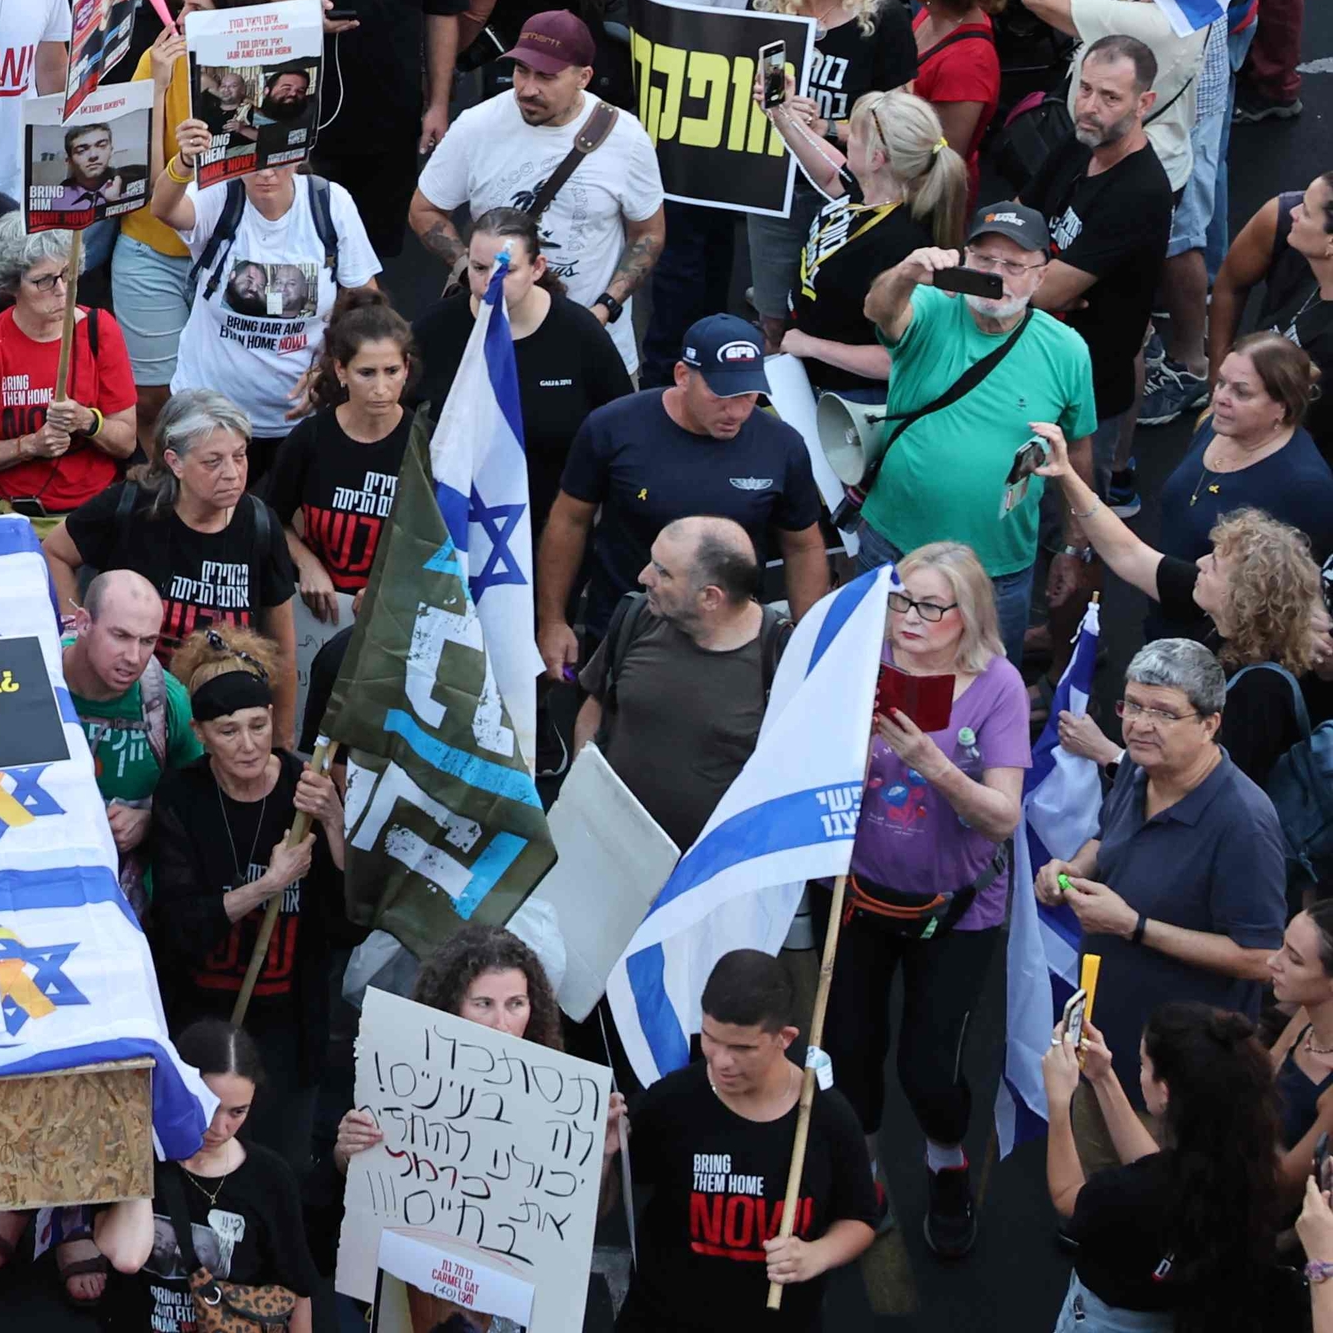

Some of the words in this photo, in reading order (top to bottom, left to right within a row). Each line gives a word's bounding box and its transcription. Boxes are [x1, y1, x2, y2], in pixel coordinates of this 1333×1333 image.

[241, 50, 255, 60] AND
[256, 48, 273, 58] EITAN
[274, 46, 292, 57] HORN
[199, 145, 227, 166] THEM
[28, 184, 64, 204] BRING
[29, 197, 52, 213] HIM
[28, 210, 61, 227] HOME
[63, 208, 95, 224] NOW!
[227, 315, 258, 333] BRING
[259, 320, 281, 336] IAIR
[282, 321, 306, 336] AND
[246, 334, 277, 352] HOME
[276, 333, 308, 351] NOW!
[1, 374, 29, 392] BRING
[1, 389, 26, 408] THEM
[26, 387, 54, 406] HOME
[331, 486, 377, 515] הביתה
[201, 560, 249, 586] מחזירים
[169, 575, 214, 606] הביתה
[692, 1153, 732, 1175] BRING
[692, 1173, 726, 1194] THEM
[727, 1176, 765, 1197] HOME
[442, 1258, 454, 1275] גת
[454, 1262, 475, 1281] כרמל
[431, 1267, 464, 1288] CARMEL
[463, 1278, 480, 1296] GAT
